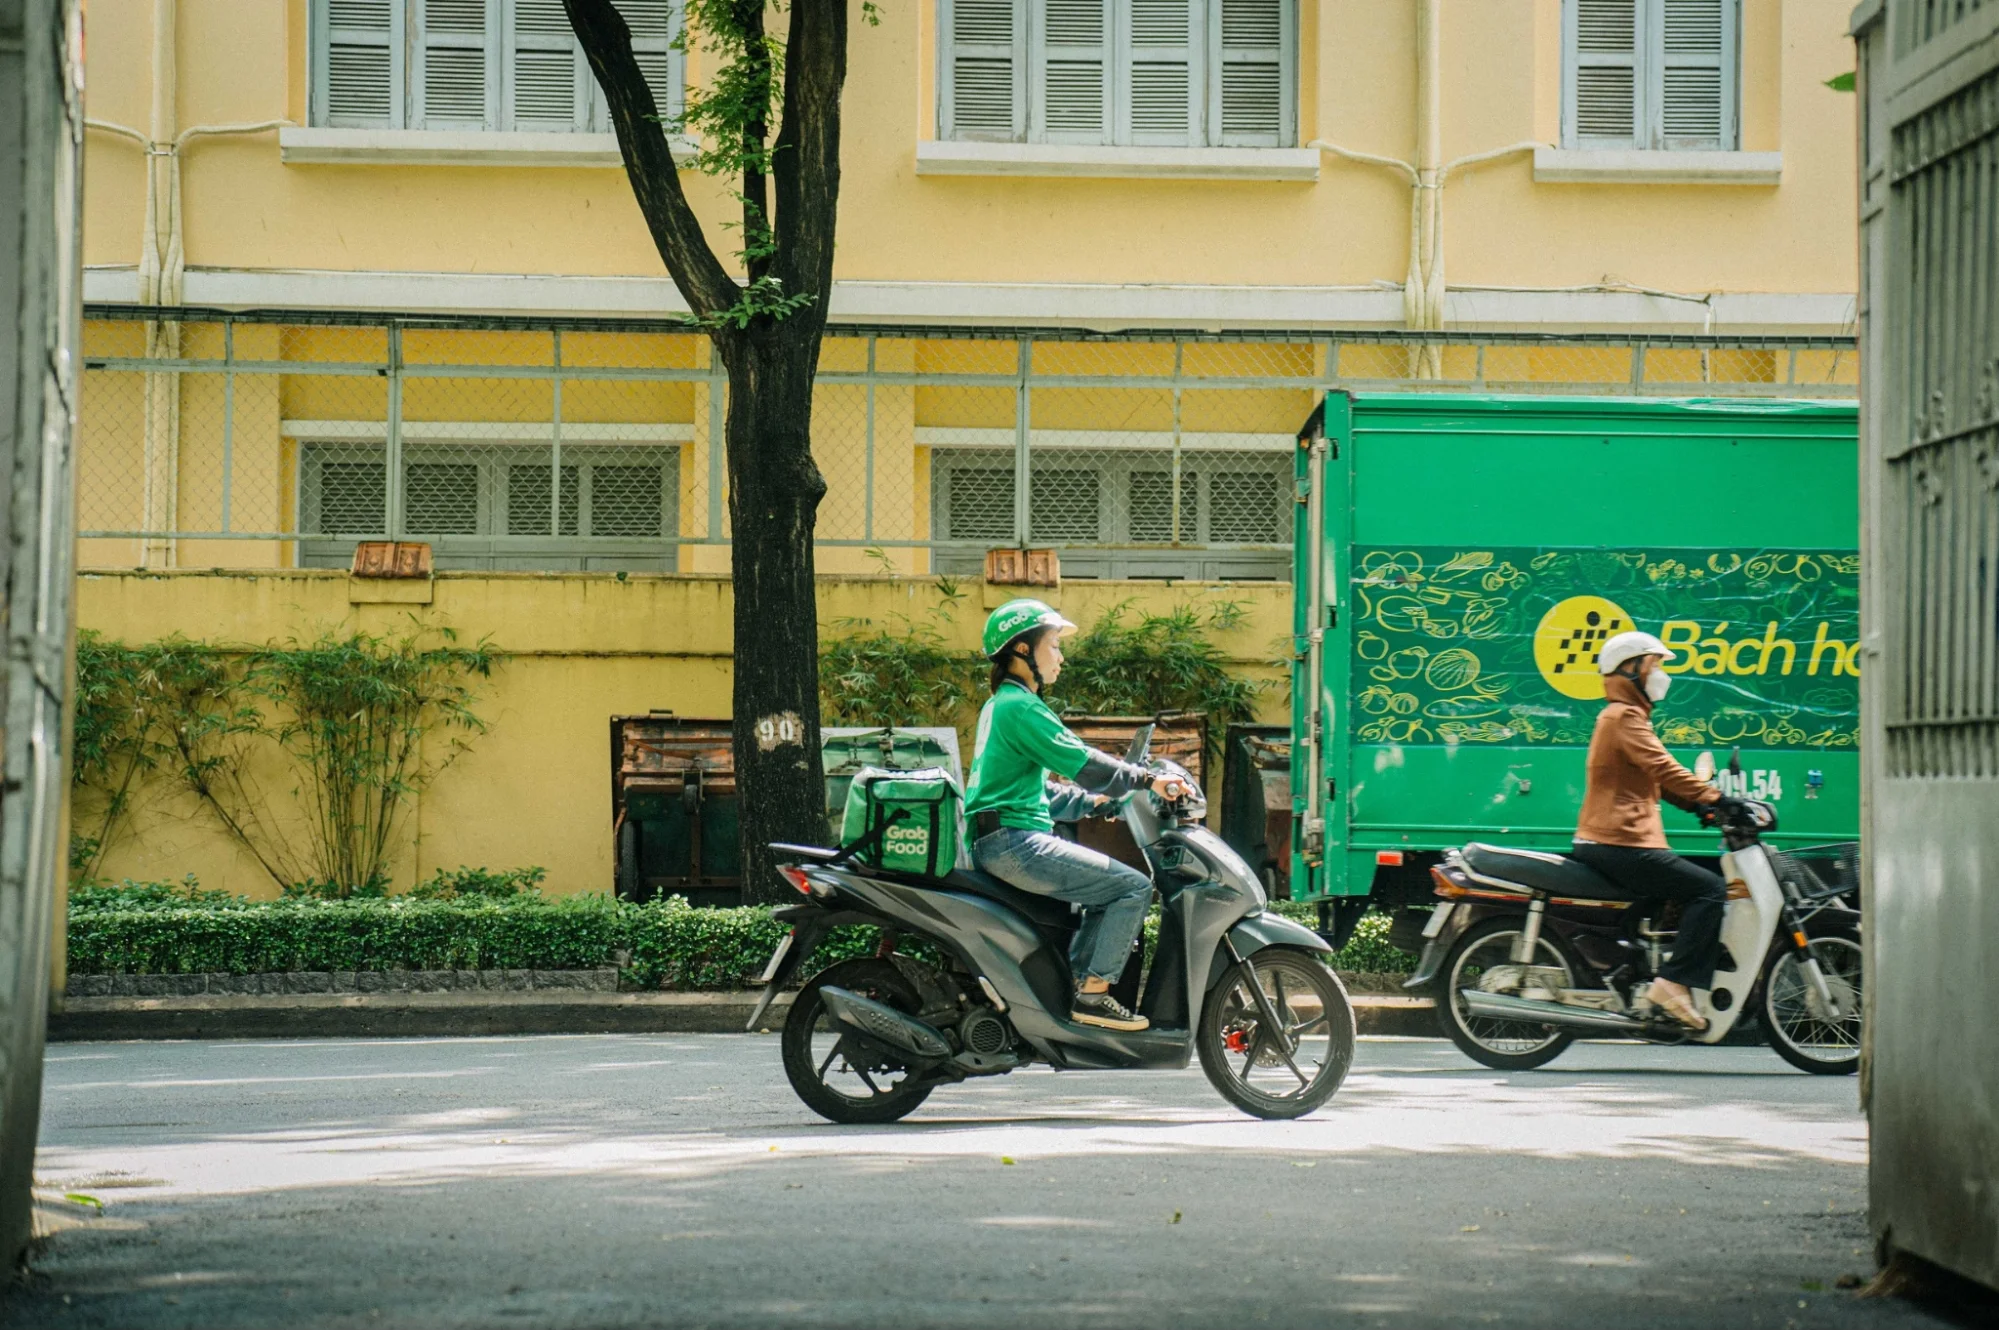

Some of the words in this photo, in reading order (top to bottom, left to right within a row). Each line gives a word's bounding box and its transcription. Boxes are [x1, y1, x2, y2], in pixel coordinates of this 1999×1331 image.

[1659, 619, 1797, 676] Bách
[760, 719, 794, 741] 90
[1704, 768, 1783, 801] 09.54
[886, 825, 929, 840] Grab
[886, 841, 928, 855] Food
